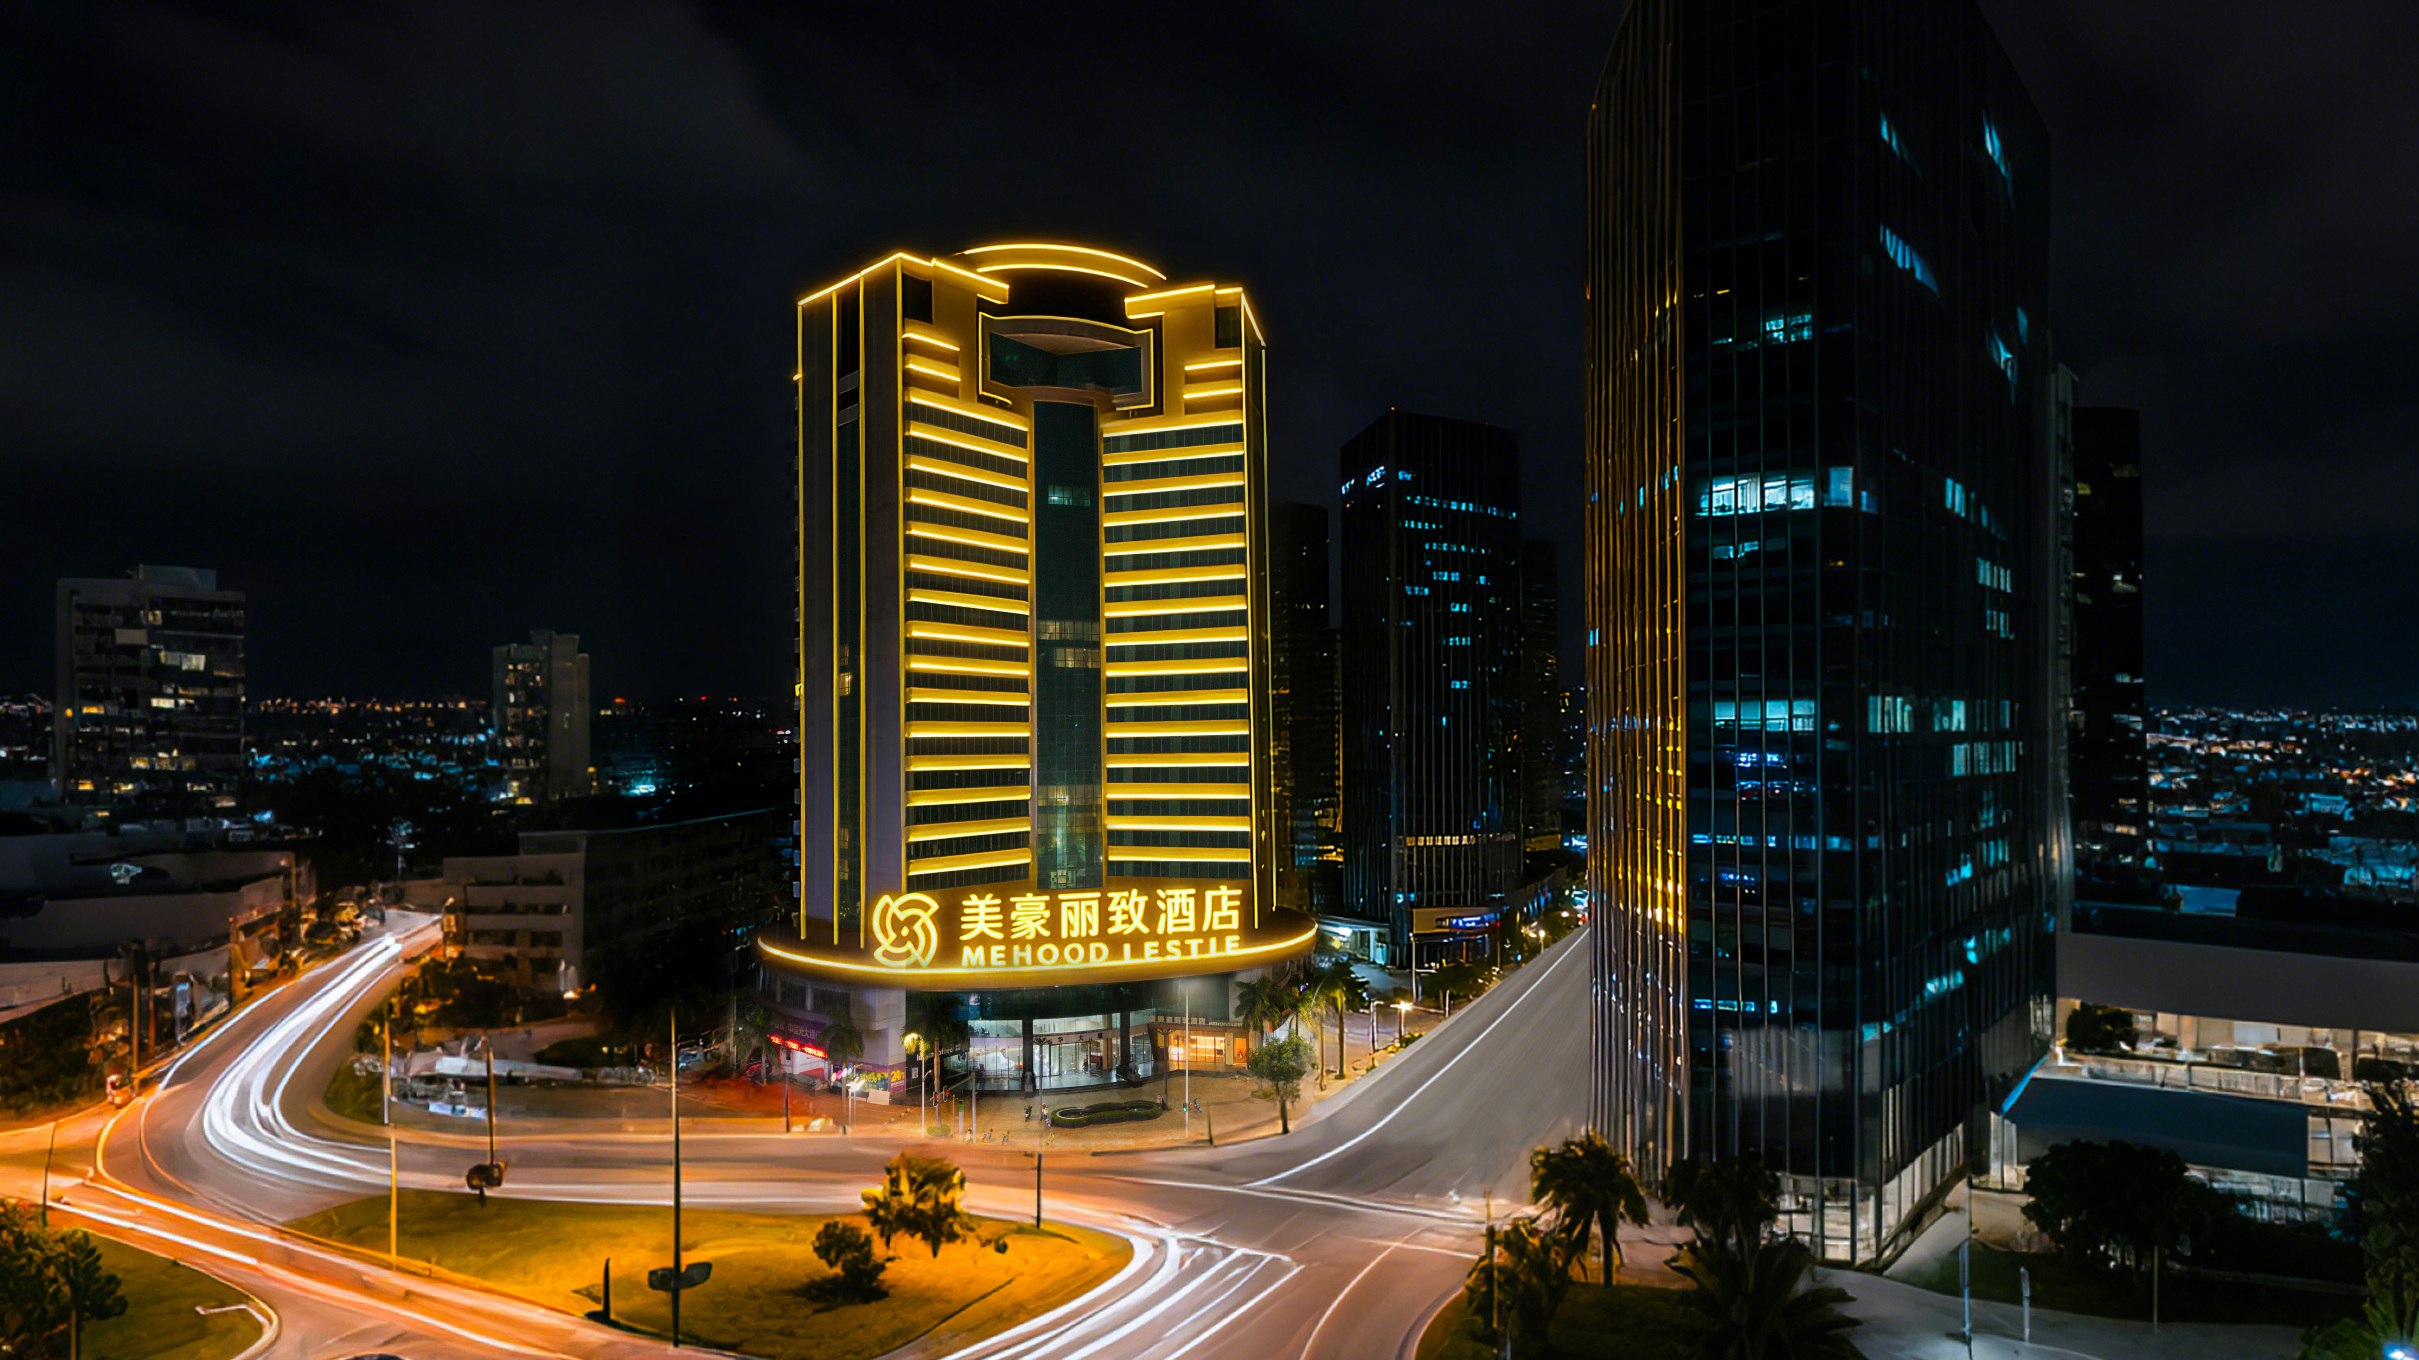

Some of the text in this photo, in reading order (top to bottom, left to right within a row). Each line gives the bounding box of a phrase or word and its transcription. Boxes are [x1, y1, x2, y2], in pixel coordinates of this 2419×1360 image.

[959, 885, 1243, 941] 美豪丽致酒店
[961, 942, 1109, 967] MEHOOD
